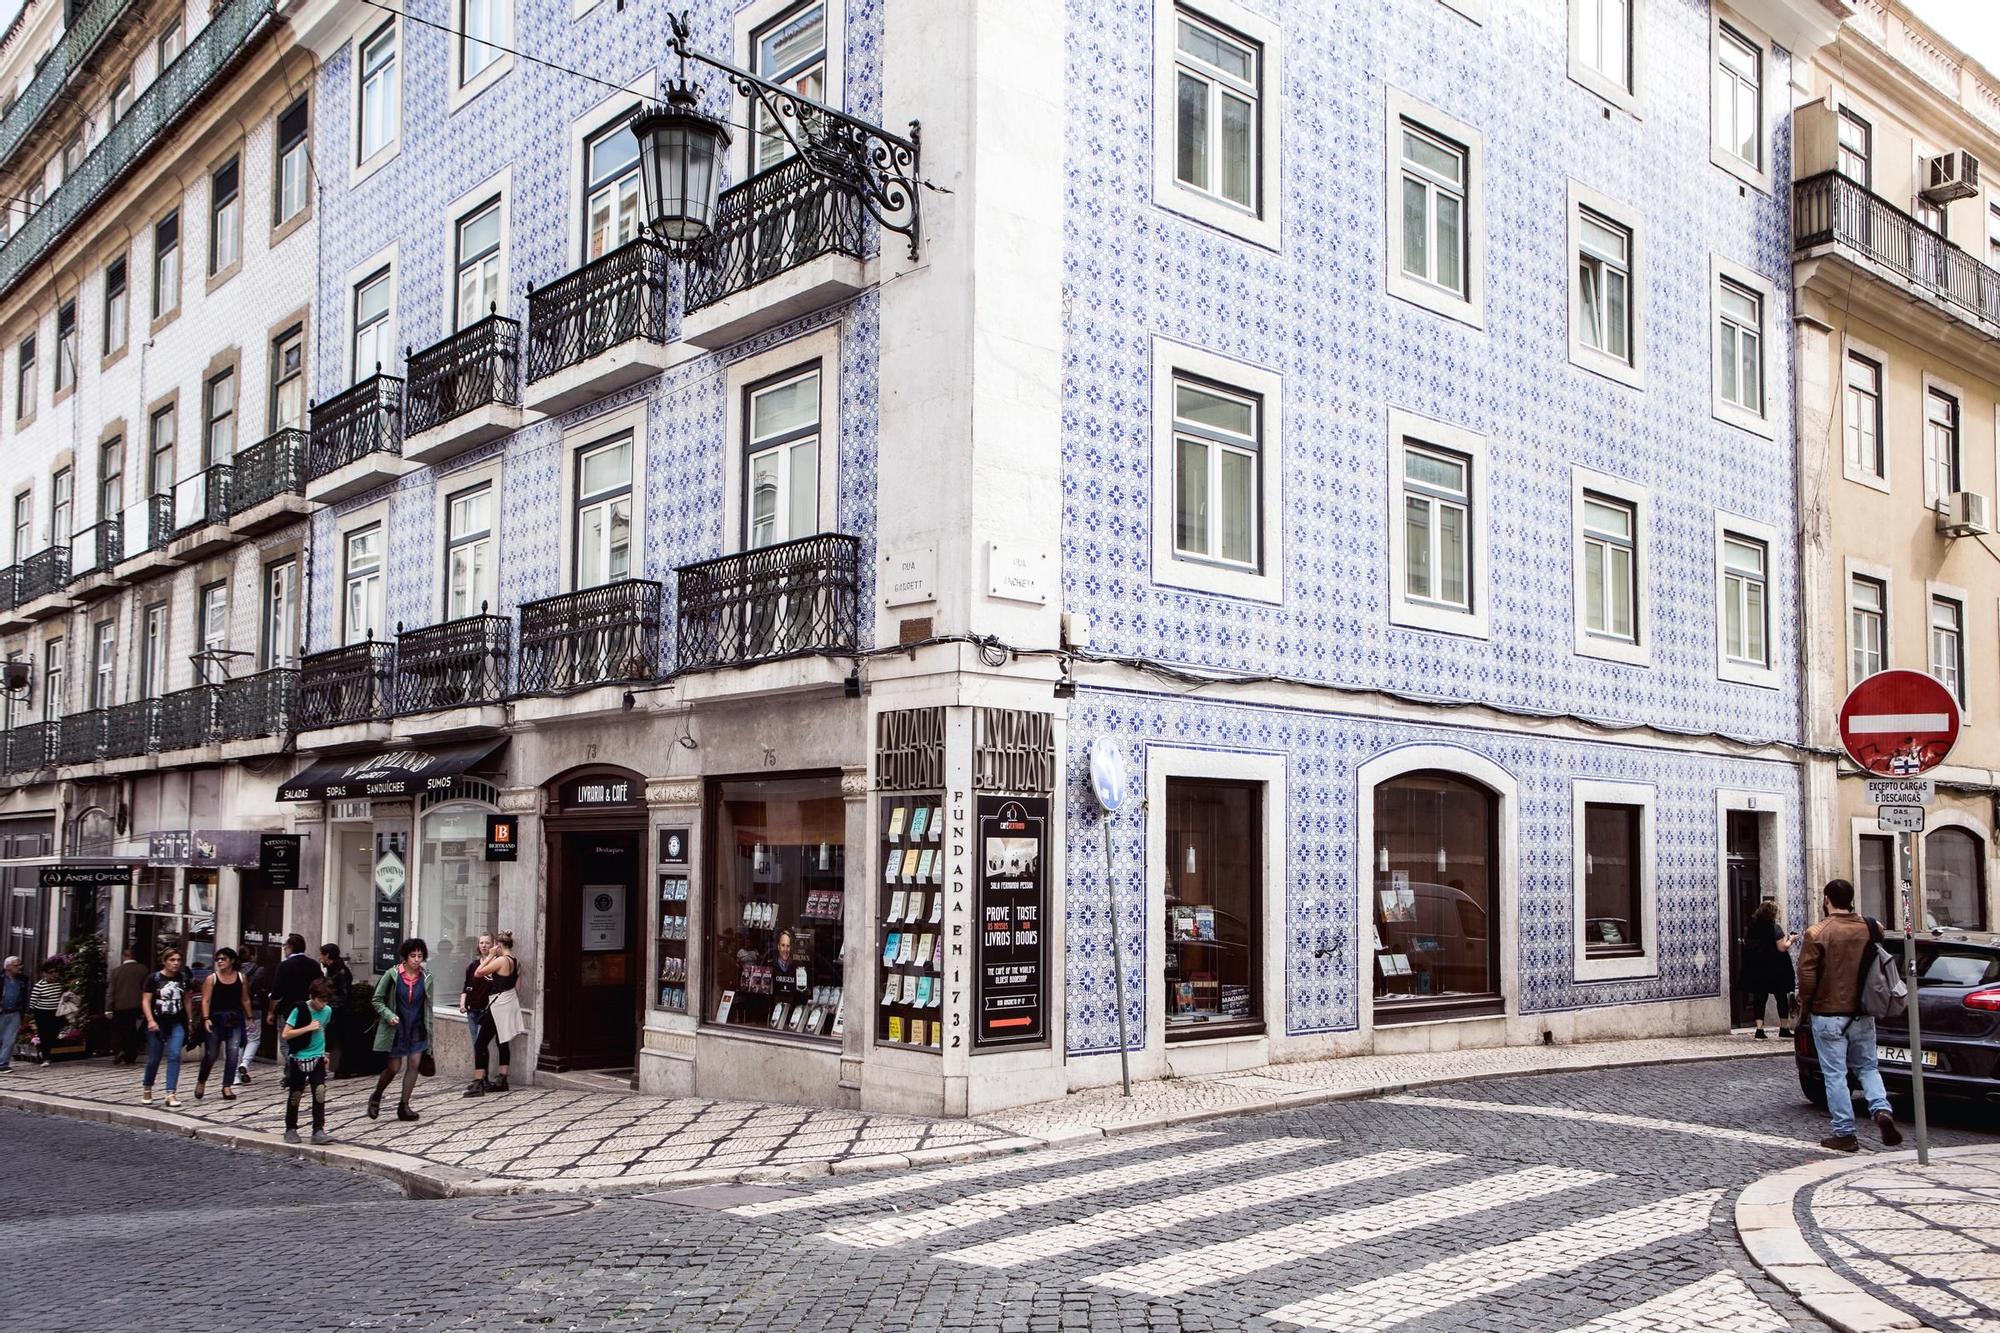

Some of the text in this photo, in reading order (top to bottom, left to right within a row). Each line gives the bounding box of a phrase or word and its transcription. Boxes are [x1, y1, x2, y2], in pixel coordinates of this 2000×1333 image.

[877, 707, 946, 750] LIVRARIA
[975, 707, 1055, 752] LIVRARIA
[586, 744, 597, 759] 73
[763, 749, 777, 767] 75
[875, 747, 946, 790] BERTRAND
[974, 748, 1056, 791] BERTRAND
[284, 776, 452, 799] SALADAS SOPAS SANDUÍCHES SUMOS
[578, 781, 628, 803] LIVRARIA & CAFÉ
[1869, 781, 1928, 792] EXCEPTO CARGAS
[1875, 793, 1921, 803] E DESCARGAS
[498, 826, 508, 839] B
[953, 791, 964, 912] FUNDADA
[986, 907, 1010, 921] PROVE
[1016, 906, 1037, 920] TASTE
[985, 931, 1010, 947] LIVROS
[1015, 931, 1038, 945] BOOKS
[1222, 994, 1249, 1003] MAGNUM
[951, 966, 961, 1048] 1732
[1885, 1047, 1906, 1060] RA
